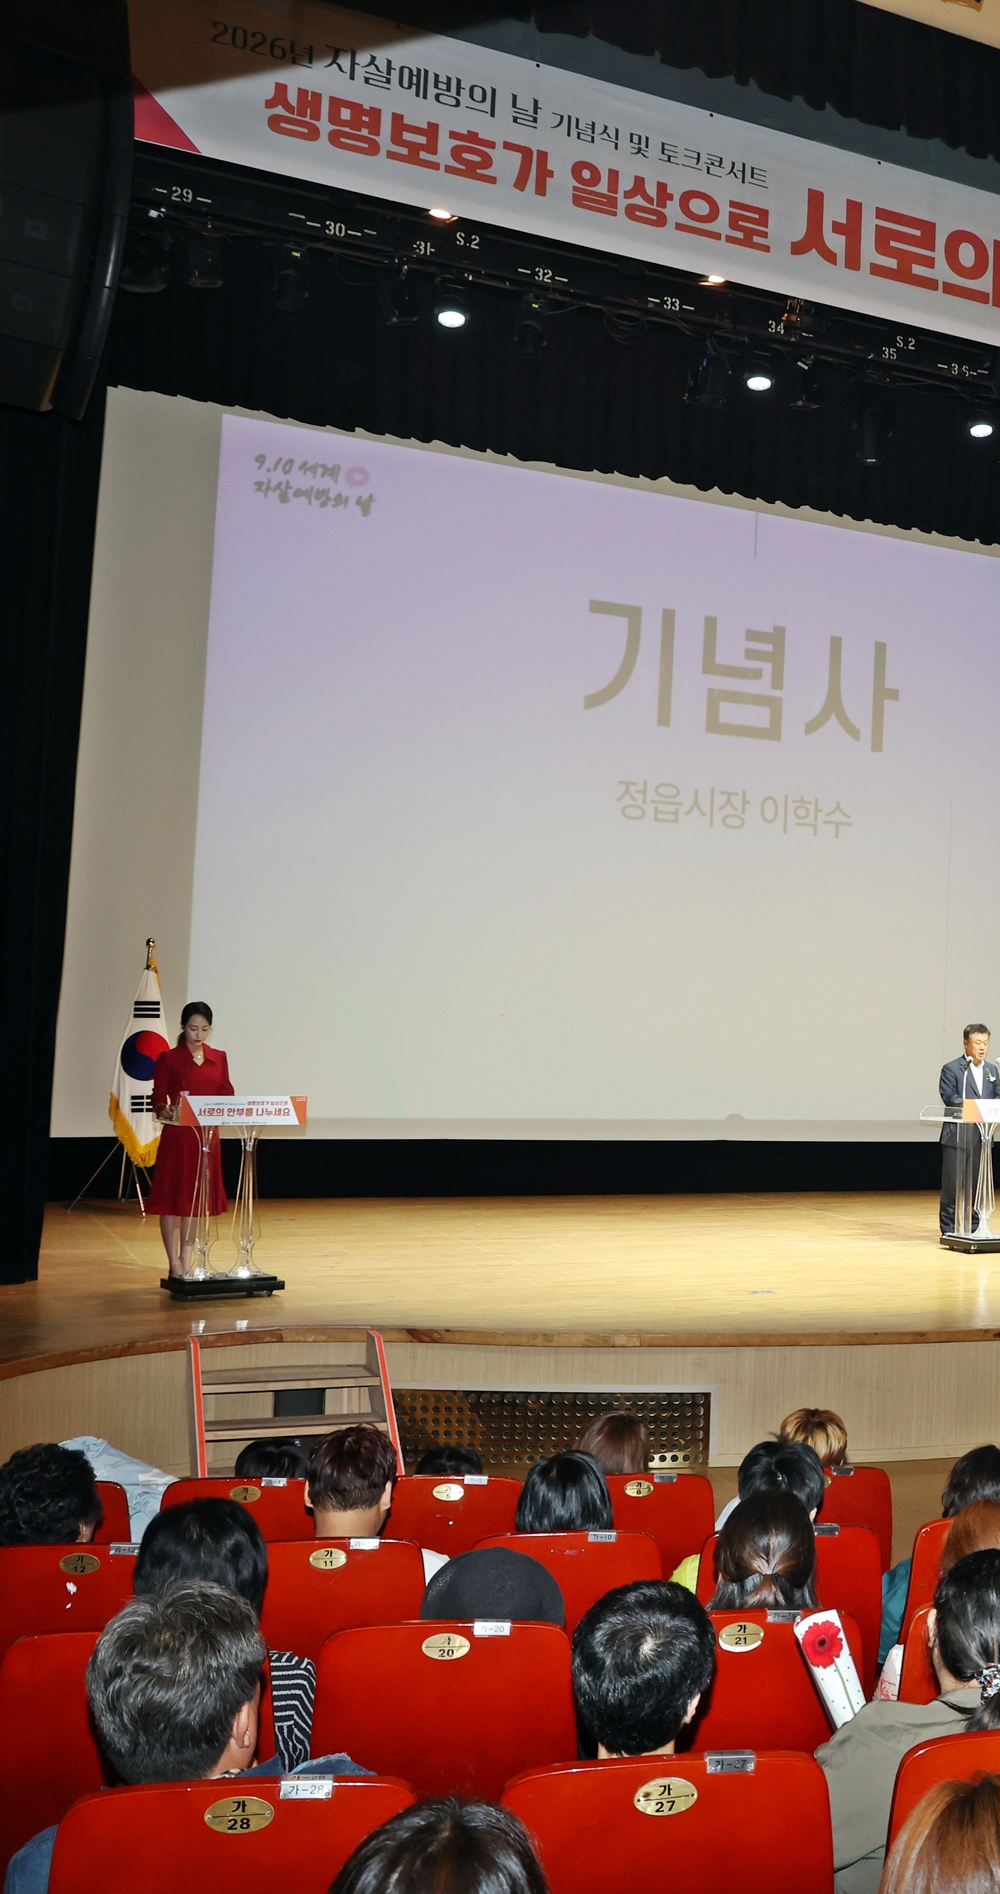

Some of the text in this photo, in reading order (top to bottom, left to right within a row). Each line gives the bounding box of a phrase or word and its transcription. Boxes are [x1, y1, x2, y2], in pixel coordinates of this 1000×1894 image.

[211, 21, 769, 189] 2026년 자살예방의 날 기념식 및 토크콘서트
[265, 81, 554, 197] 생명보호가
[571, 160, 771, 253] 일상으로
[456, 231, 480, 249] S.2
[768, 320, 785, 336] 34
[896, 335, 915, 350] S.2
[881, 347, 897, 360] 35
[254, 453, 341, 484] 9.10 세계
[253, 477, 376, 517] 자살예방의 날
[583, 599, 900, 753] 기념사
[616, 780, 853, 838] 정읍시장 이학수
[197, 1108, 290, 1117] 서로의 안부를 나누세요
[737, 1624, 747, 1633] 가
[734, 1637, 747, 1645] 21
[438, 1648, 454, 1657] 20
[715, 1759, 747, 1770] 가-27
[288, 1785, 324, 1795] 가-28
[658, 1784, 672, 1796] 가
[232, 1800, 247, 1813] 가
[655, 1800, 675, 1812] 27
[227, 1817, 250, 1830] 28
